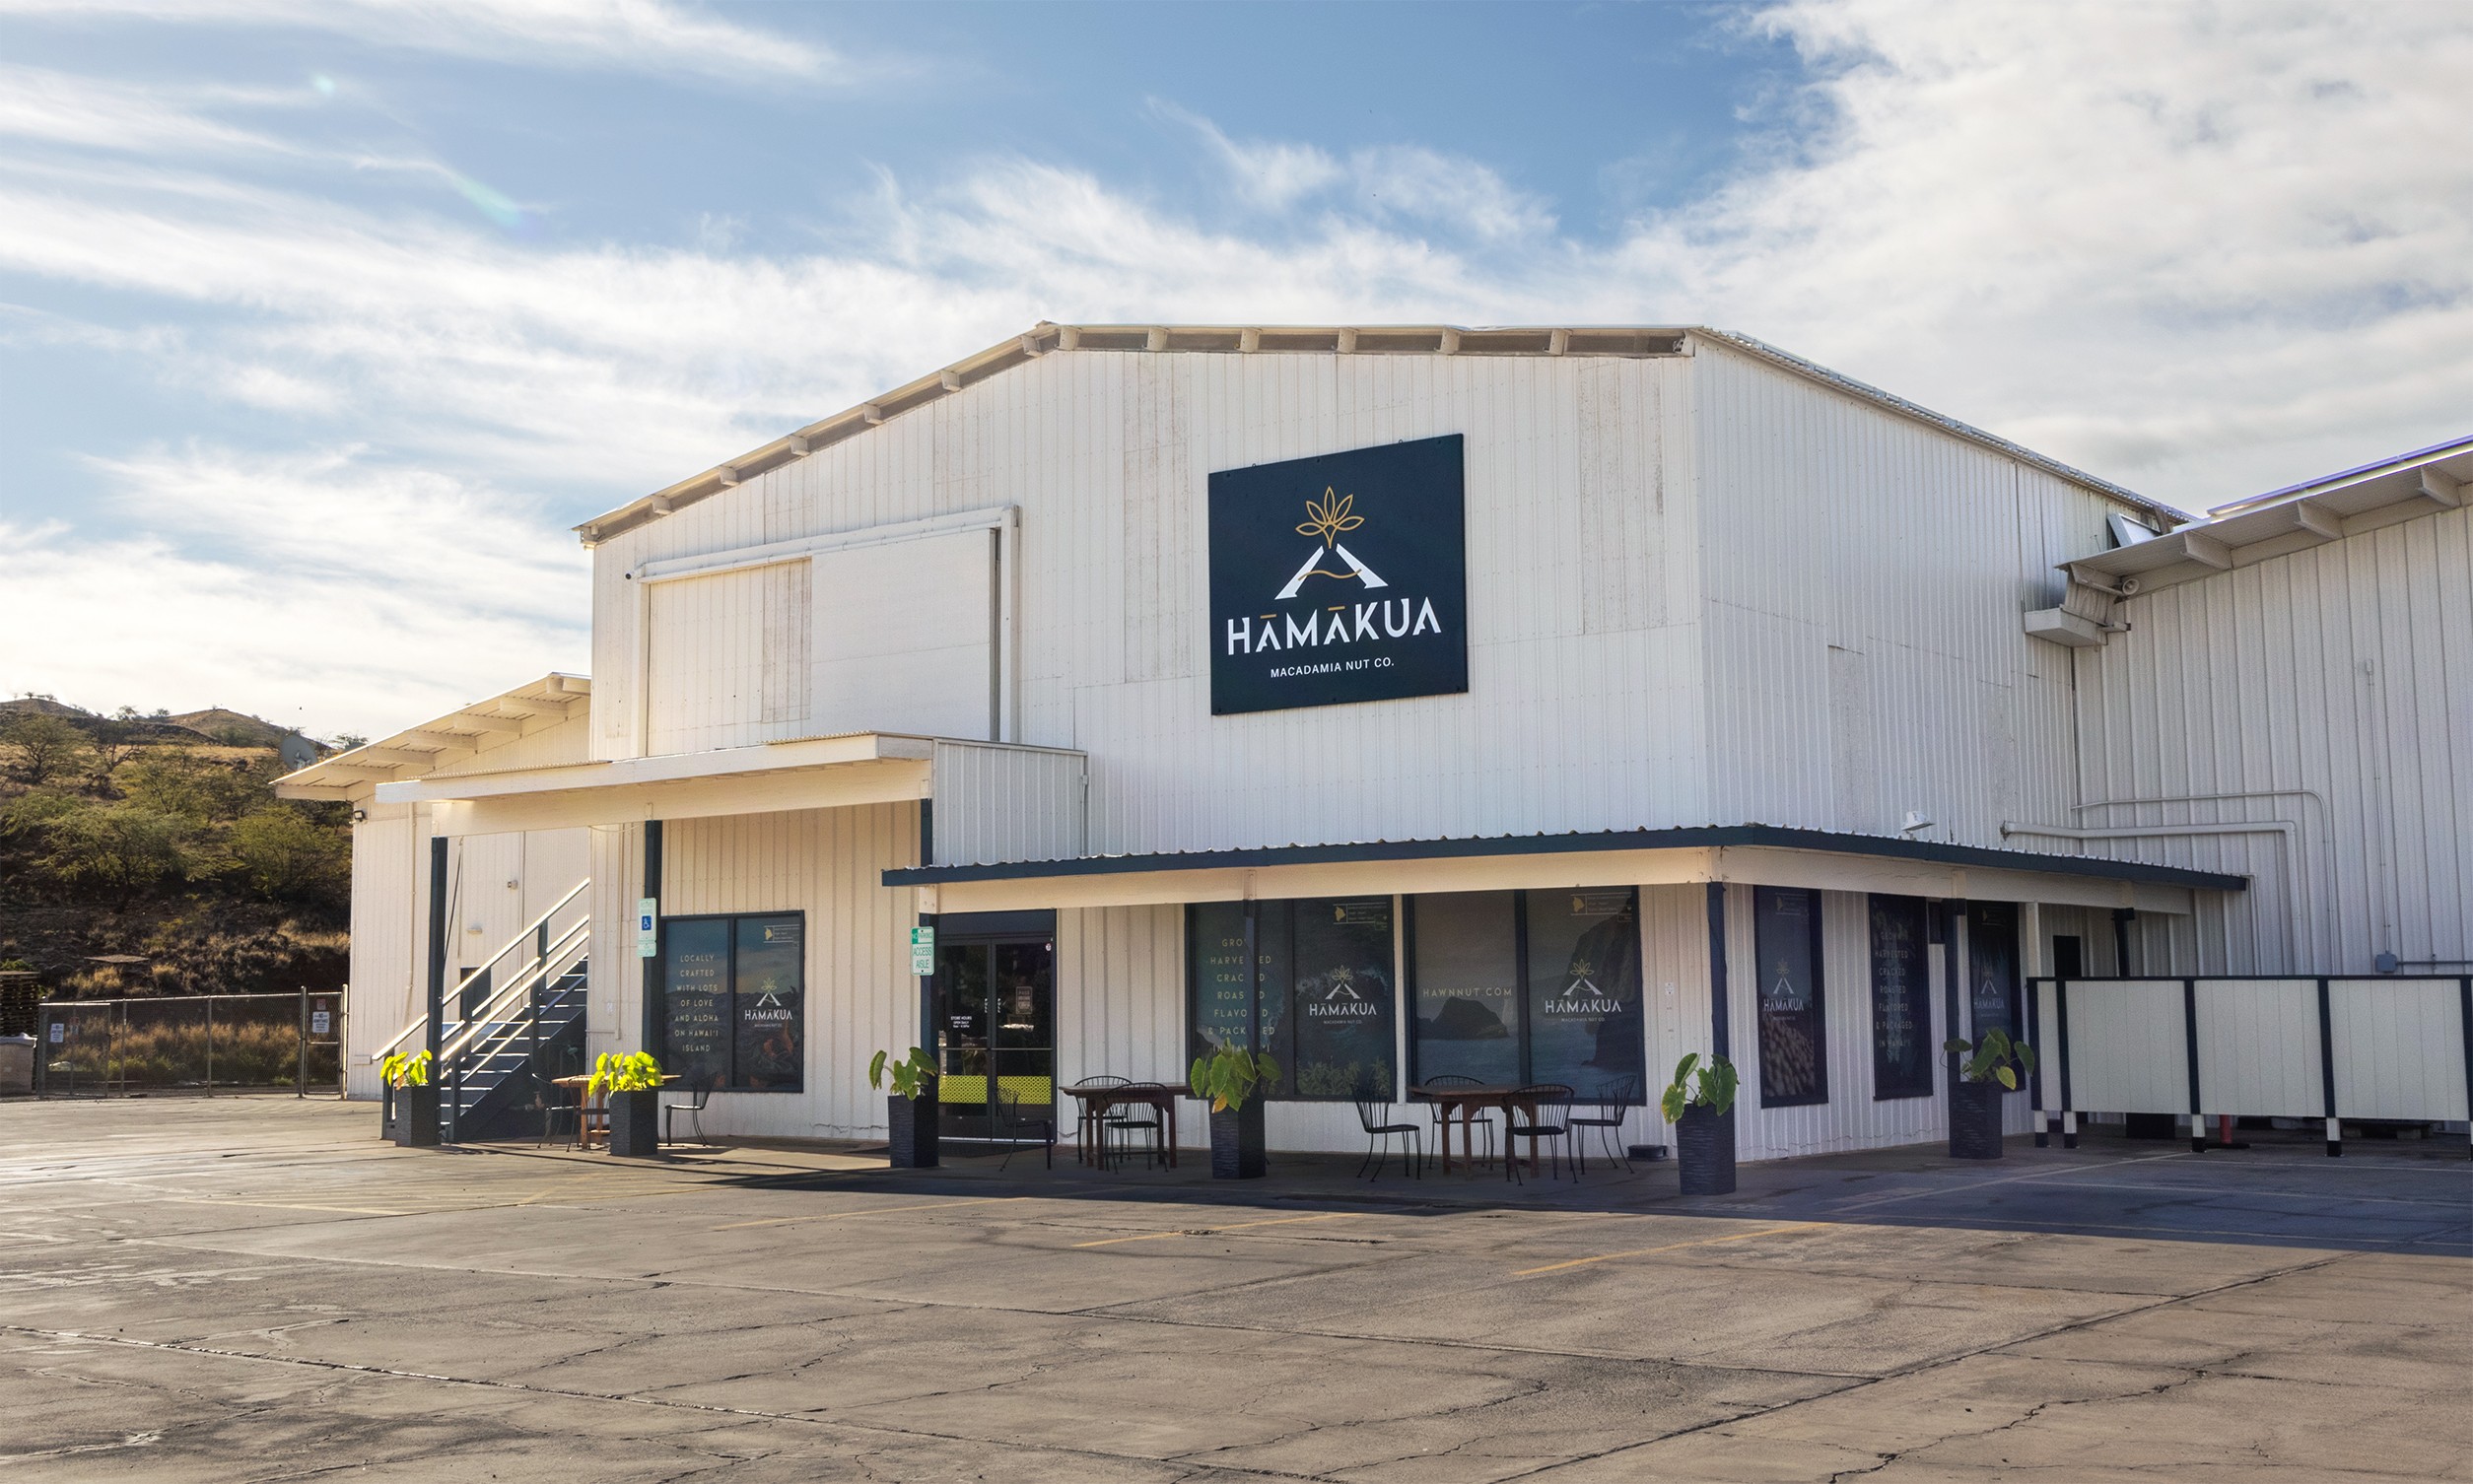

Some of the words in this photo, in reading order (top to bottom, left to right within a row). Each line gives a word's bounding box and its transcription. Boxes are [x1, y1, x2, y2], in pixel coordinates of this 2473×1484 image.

[1227, 596, 1442, 655] HĀMĀKUA
[1271, 662, 1341, 678] MACADAMIA
[1345, 658, 1370, 671] NUT
[1374, 656, 1395, 668] CO.
[1222, 938, 1247, 947] GRO
[913, 946, 932, 956] ACCESS
[680, 954, 715, 963] LOCALLY
[1210, 955, 1271, 965] HARVEED
[916, 959, 929, 969] AISLE
[679, 969, 715, 978] CRAFTED
[1216, 973, 1266, 982] CRACD
[1217, 990, 1266, 1000] ROASD
[1422, 986, 1513, 997] HAWNNUT.COM
[1309, 1002, 1377, 1016] HĀMĀKUA
[1545, 998, 1622, 1014] HĀMĀKUA
[1213, 1008, 1269, 1018] FLAVOD
[1207, 1027, 1213, 1036] &
[1219, 1026, 1275, 1036] PACKED
